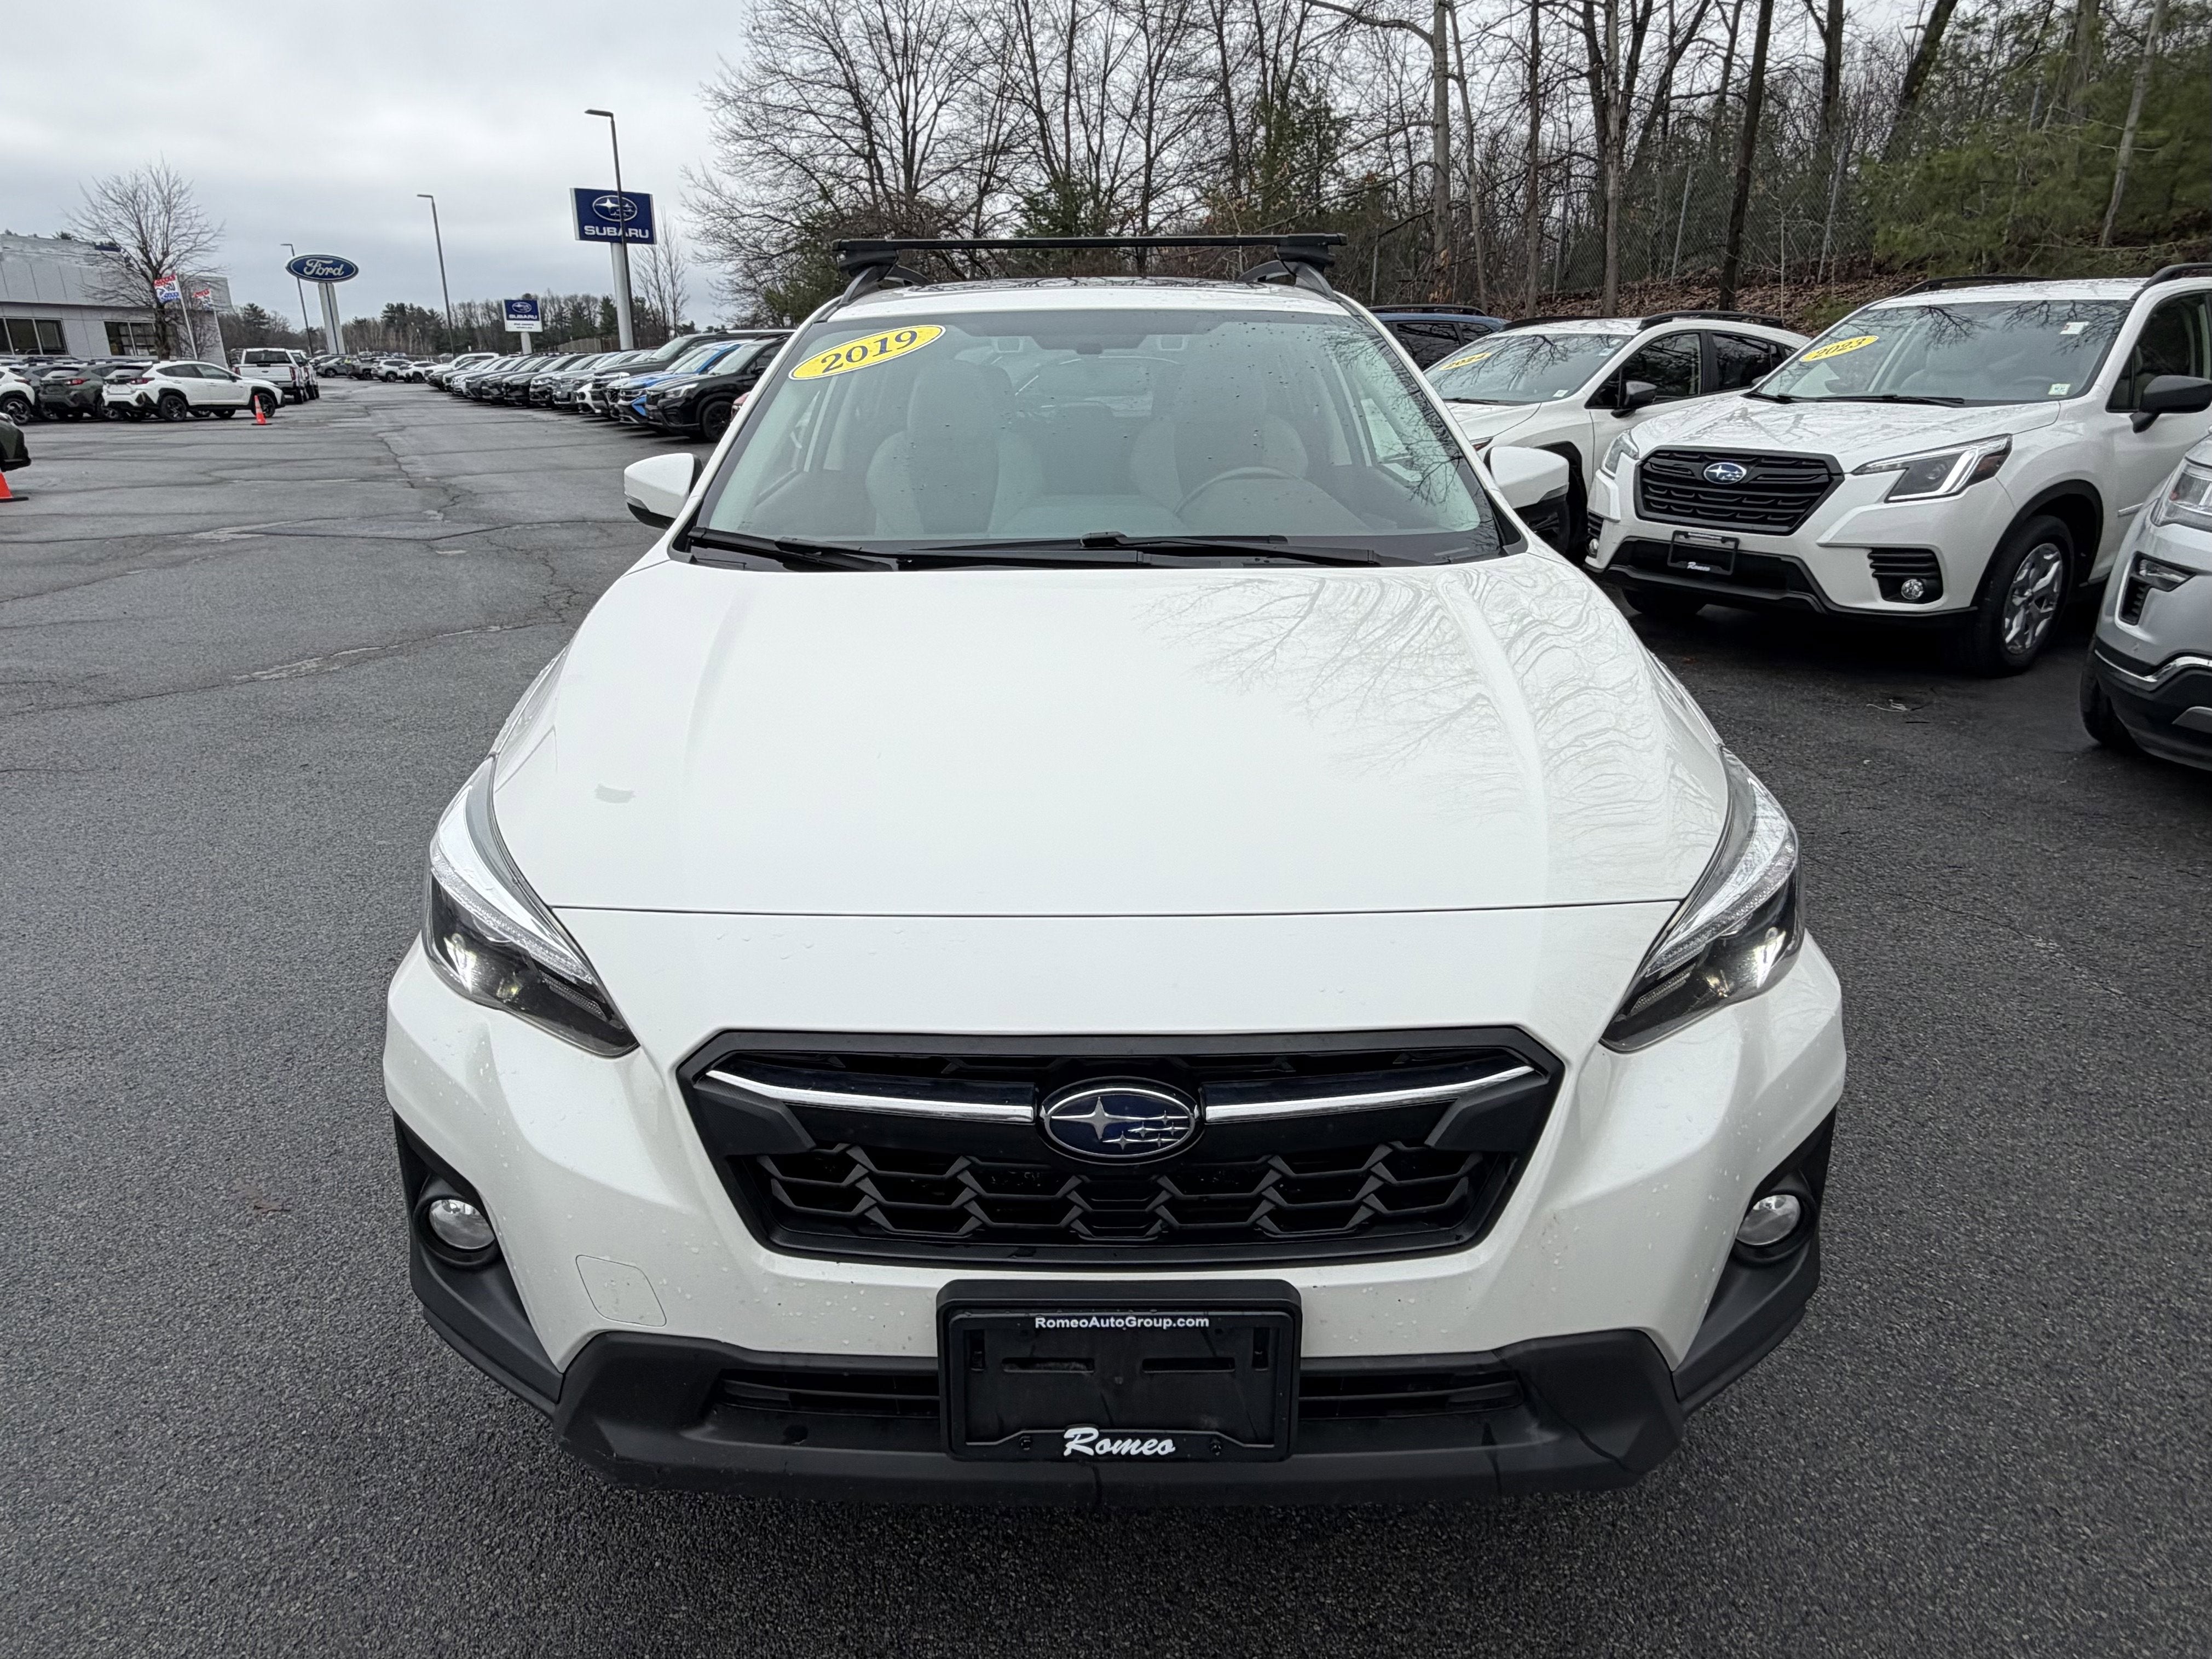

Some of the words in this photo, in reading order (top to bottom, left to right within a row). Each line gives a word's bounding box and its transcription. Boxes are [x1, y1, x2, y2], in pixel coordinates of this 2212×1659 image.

[584, 225, 649, 239] SUBARU
[303, 258, 344, 276] Ford
[821, 331, 917, 373] 2019
[1812, 338, 1867, 359] 2023
[1035, 1316, 1209, 1329] RomeoAutoGroup.com
[1064, 1427, 1176, 1456] Romeo
